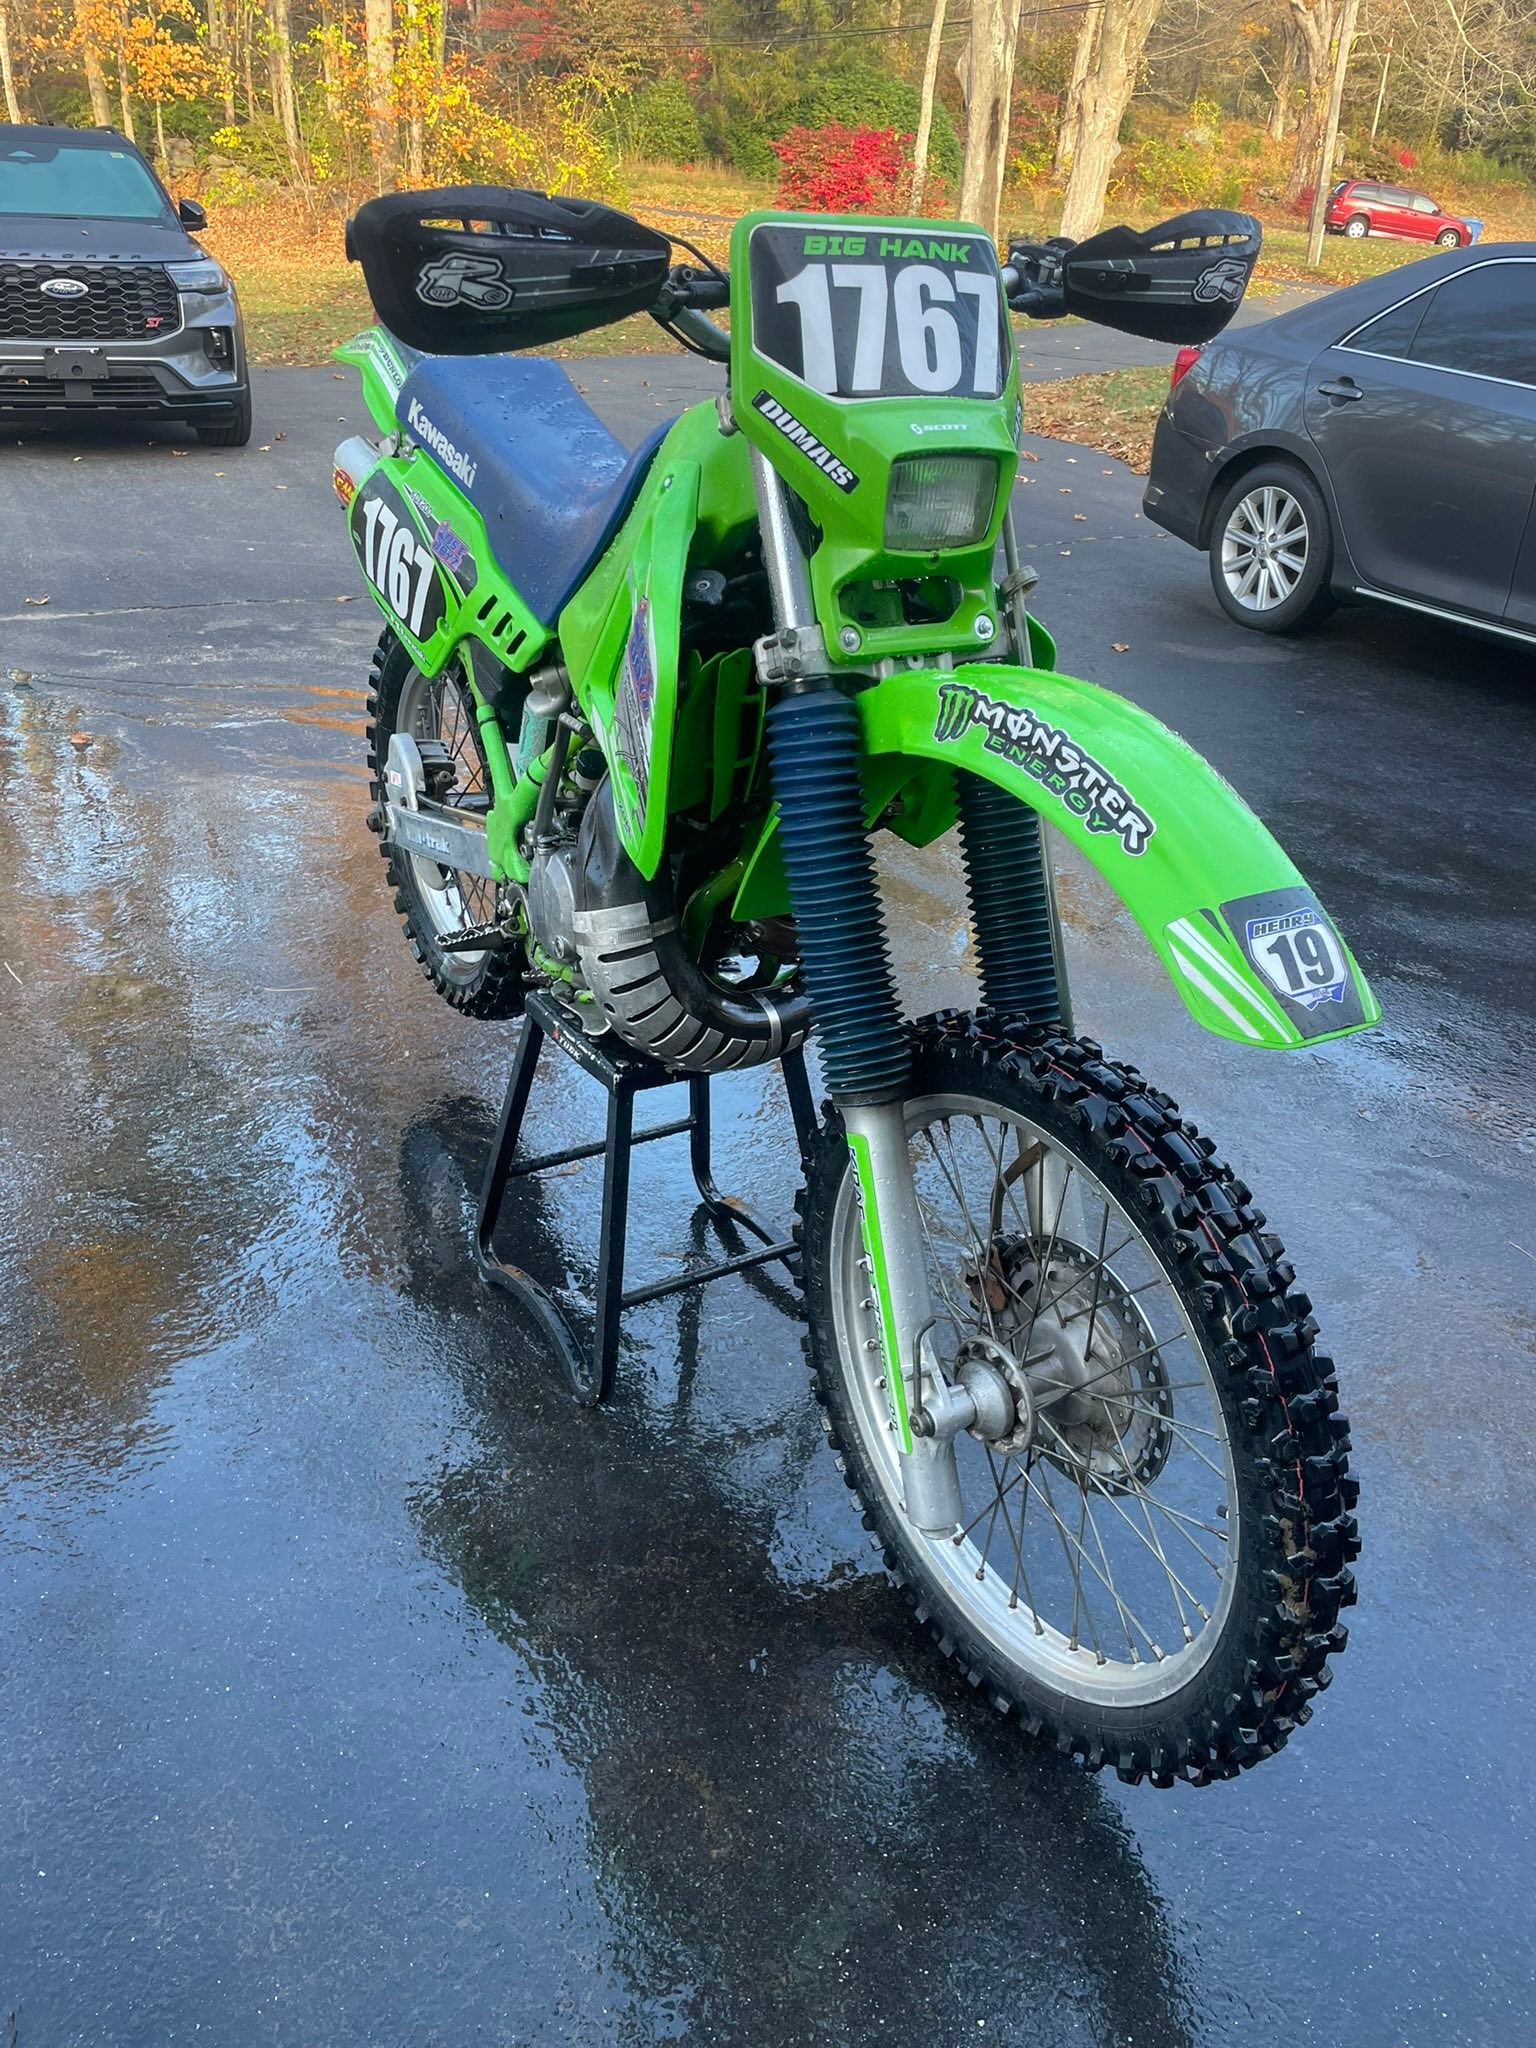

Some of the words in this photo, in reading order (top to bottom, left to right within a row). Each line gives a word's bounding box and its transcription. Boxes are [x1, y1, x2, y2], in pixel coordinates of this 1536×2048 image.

[803, 235, 867, 257] BIG
[879, 237, 972, 264] HANK
[145, 317, 164, 328] ST
[776, 263, 999, 394] 1767
[407, 396, 478, 489] Kawasaki
[759, 398, 855, 487] DUMAIS
[363, 497, 436, 638] 1767
[974, 700, 1148, 850] MONSTER
[989, 737, 1107, 827] ENERGY
[1253, 913, 1315, 938] HENRY
[1266, 928, 1336, 992] 19
